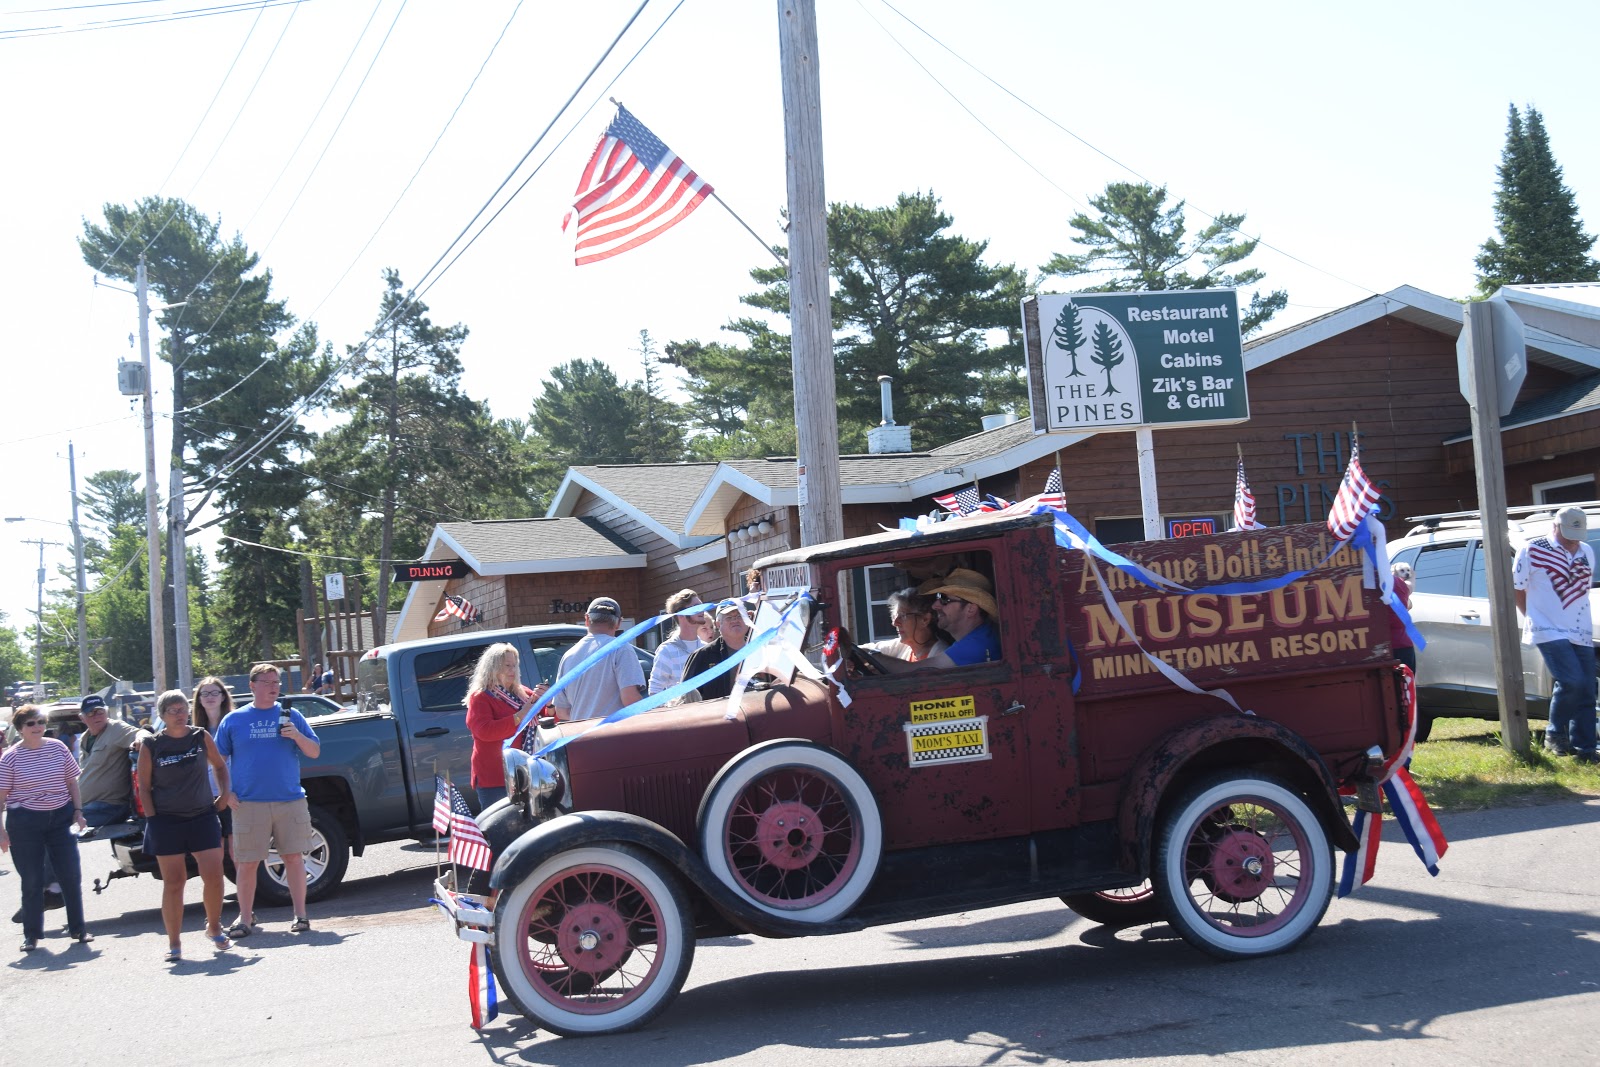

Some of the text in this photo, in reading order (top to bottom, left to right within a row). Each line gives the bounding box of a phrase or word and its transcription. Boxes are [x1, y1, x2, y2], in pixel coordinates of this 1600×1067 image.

[1127, 304, 1229, 322] Restaurant
[1163, 328, 1214, 345] Motel
[1160, 352, 1223, 369] Cabins
[1055, 384, 1097, 400] THE
[1152, 375, 1234, 393] Zik's Bar
[1166, 392, 1225, 410] & Grill
[1057, 402, 1134, 423] PINES
[1275, 479, 1396, 526] PIS
[1173, 522, 1212, 538] OPEN
[1204, 539, 1262, 581] Doll
[1265, 545, 1283, 569] &
[409, 565, 453, 578] DINING
[1081, 576, 1370, 650] MUSEUM
[1092, 627, 1369, 680] MINNETONKA RESORT
[913, 698, 972, 711] HONK IF
[913, 709, 974, 722] PARTS FALL OFF!
[915, 733, 979, 750] MOM'S TAXI
